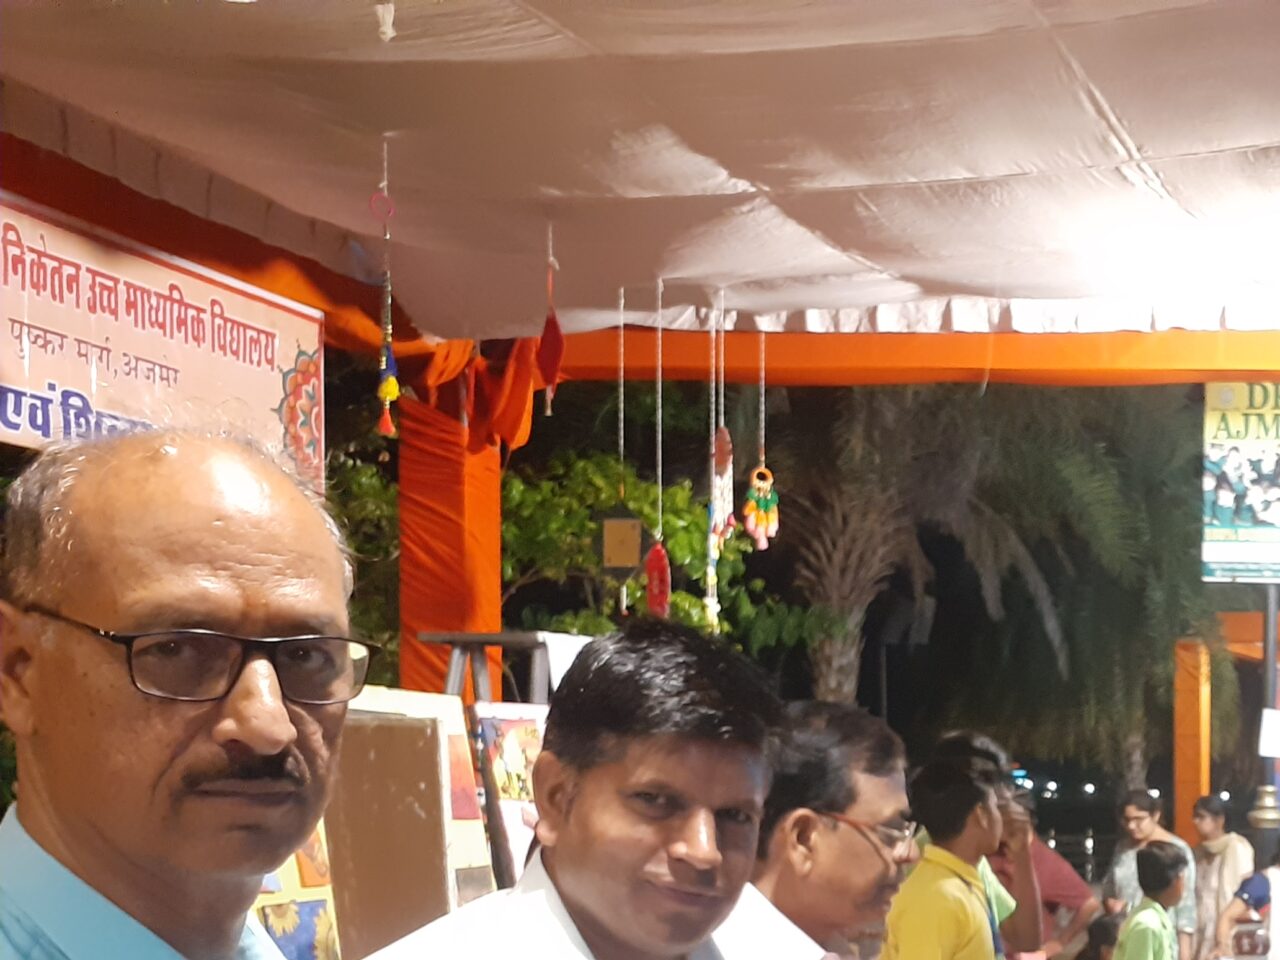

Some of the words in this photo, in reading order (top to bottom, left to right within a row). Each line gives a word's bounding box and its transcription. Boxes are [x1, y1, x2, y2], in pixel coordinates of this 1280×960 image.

[1, 222, 81, 309] निकेतन
[123, 280, 207, 348] माध्यमिक
[211, 299, 277, 371] विद्यालय
[8, 317, 68, 360] पुष्कर
[122, 351, 180, 388] अजमेर
[0, 382, 57, 439] एवं
